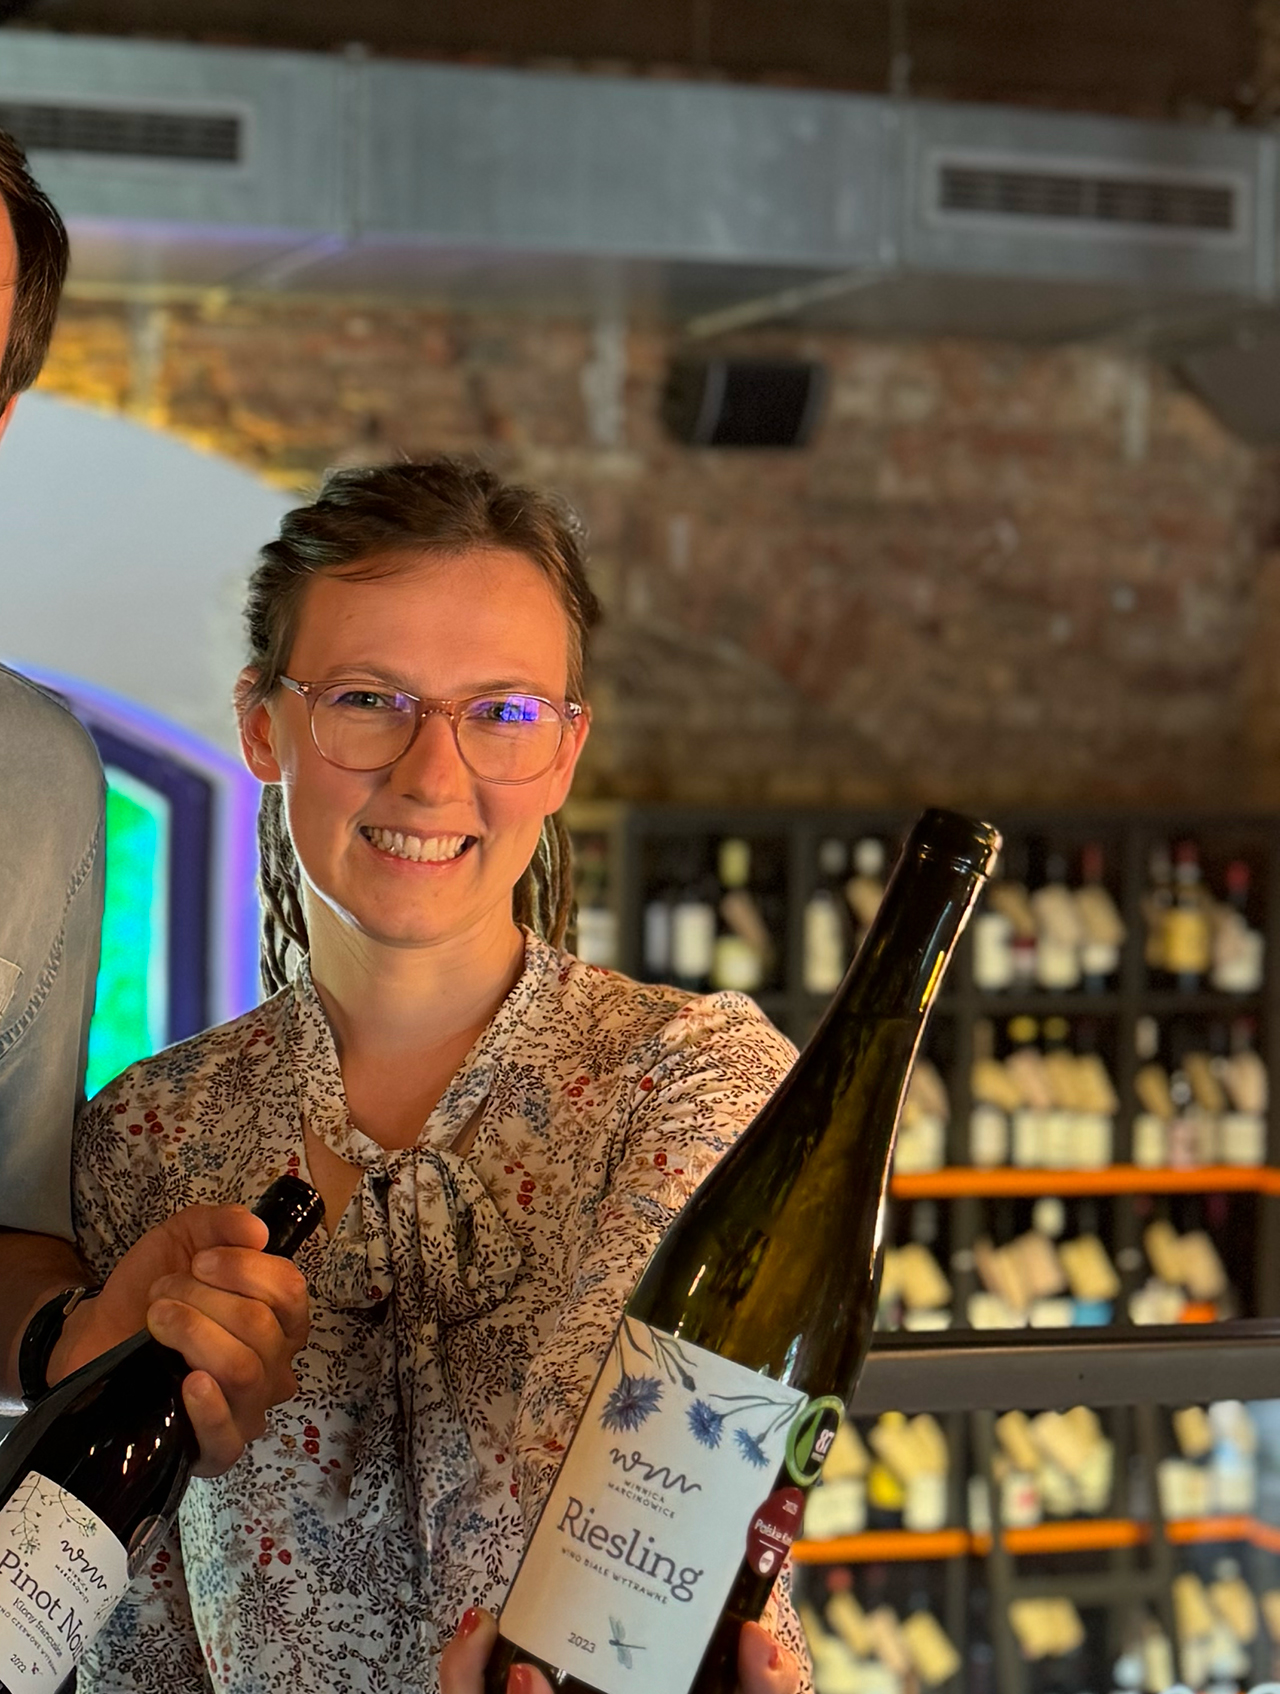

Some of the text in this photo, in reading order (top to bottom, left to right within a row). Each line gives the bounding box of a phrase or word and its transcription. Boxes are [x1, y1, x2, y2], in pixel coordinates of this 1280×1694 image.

[816, 1429, 834, 1451] 87
[556, 1495, 704, 1603] Riesling
[12, 1597, 37, 1625] Klony
[57, 1608, 87, 1661] Noir
[568, 1632, 596, 1653] 2023
